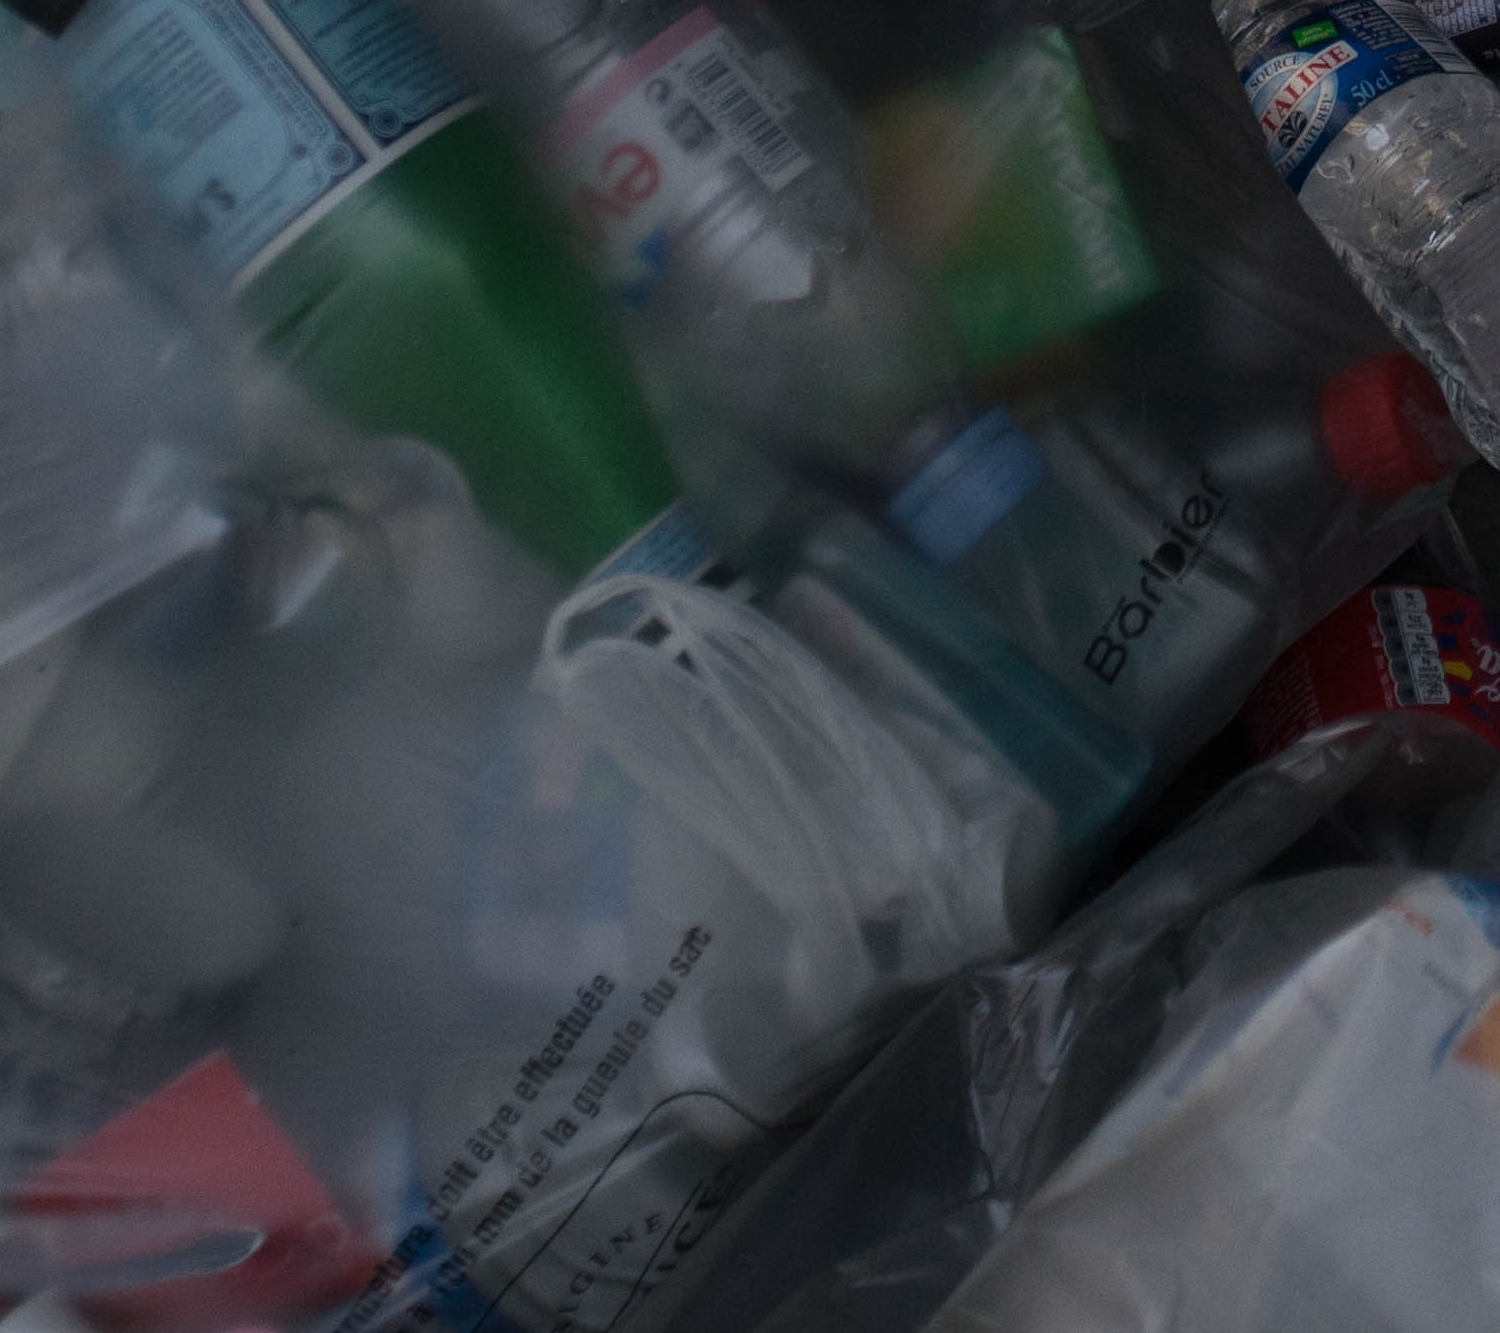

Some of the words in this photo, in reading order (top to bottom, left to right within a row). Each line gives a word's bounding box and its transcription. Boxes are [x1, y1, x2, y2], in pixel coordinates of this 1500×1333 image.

[1250, 54, 1300, 92] SOURCE
[1261, 44, 1351, 135] TALINE
[427, 1159, 481, 1221] doit
[470, 1102, 522, 1164] être
[513, 972, 617, 1105] effectuée
[517, 1150, 553, 1190] de
[541, 1115, 579, 1148] la
[572, 1017, 650, 1120] gueule
[640, 978, 679, 1019] du
